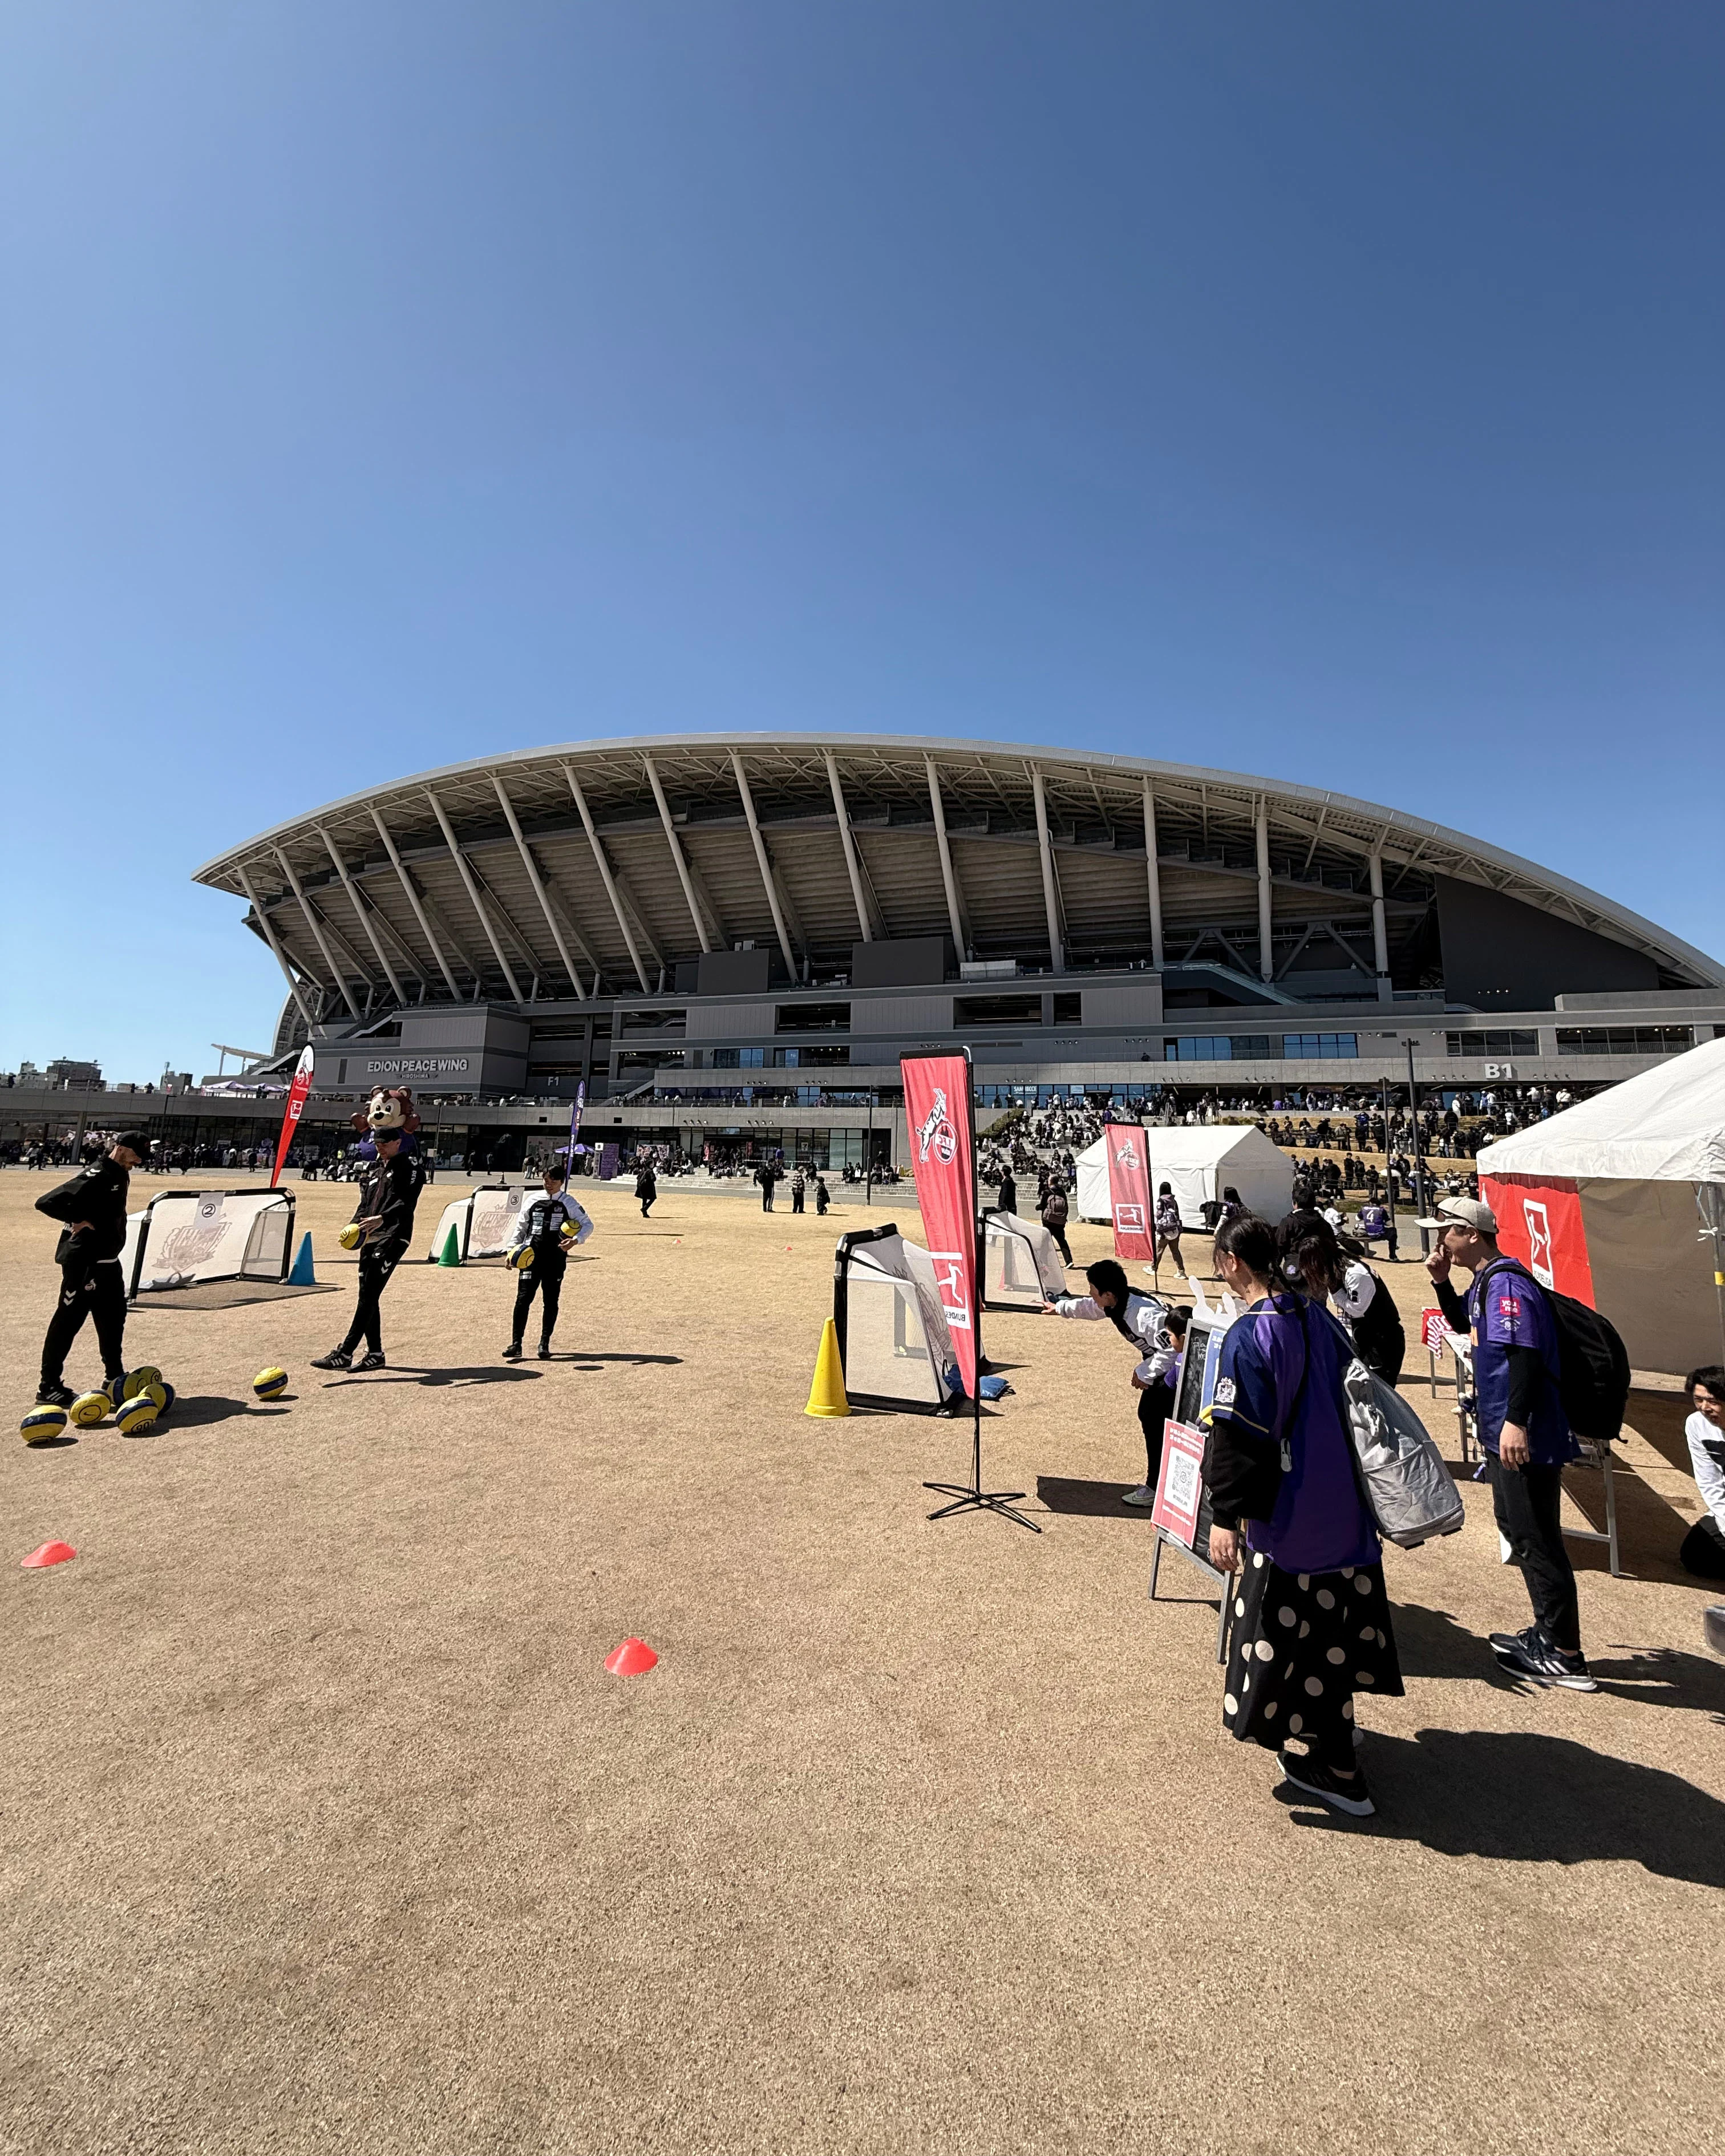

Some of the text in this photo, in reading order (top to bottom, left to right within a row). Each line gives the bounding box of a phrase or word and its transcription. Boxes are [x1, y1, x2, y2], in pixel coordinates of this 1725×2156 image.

[367, 1059, 468, 1072] EDION PEACE WING
[1484, 1063, 1512, 1079] B1
[548, 1076, 559, 1087] F1
[1366, 1210, 1374, 1223] 4
